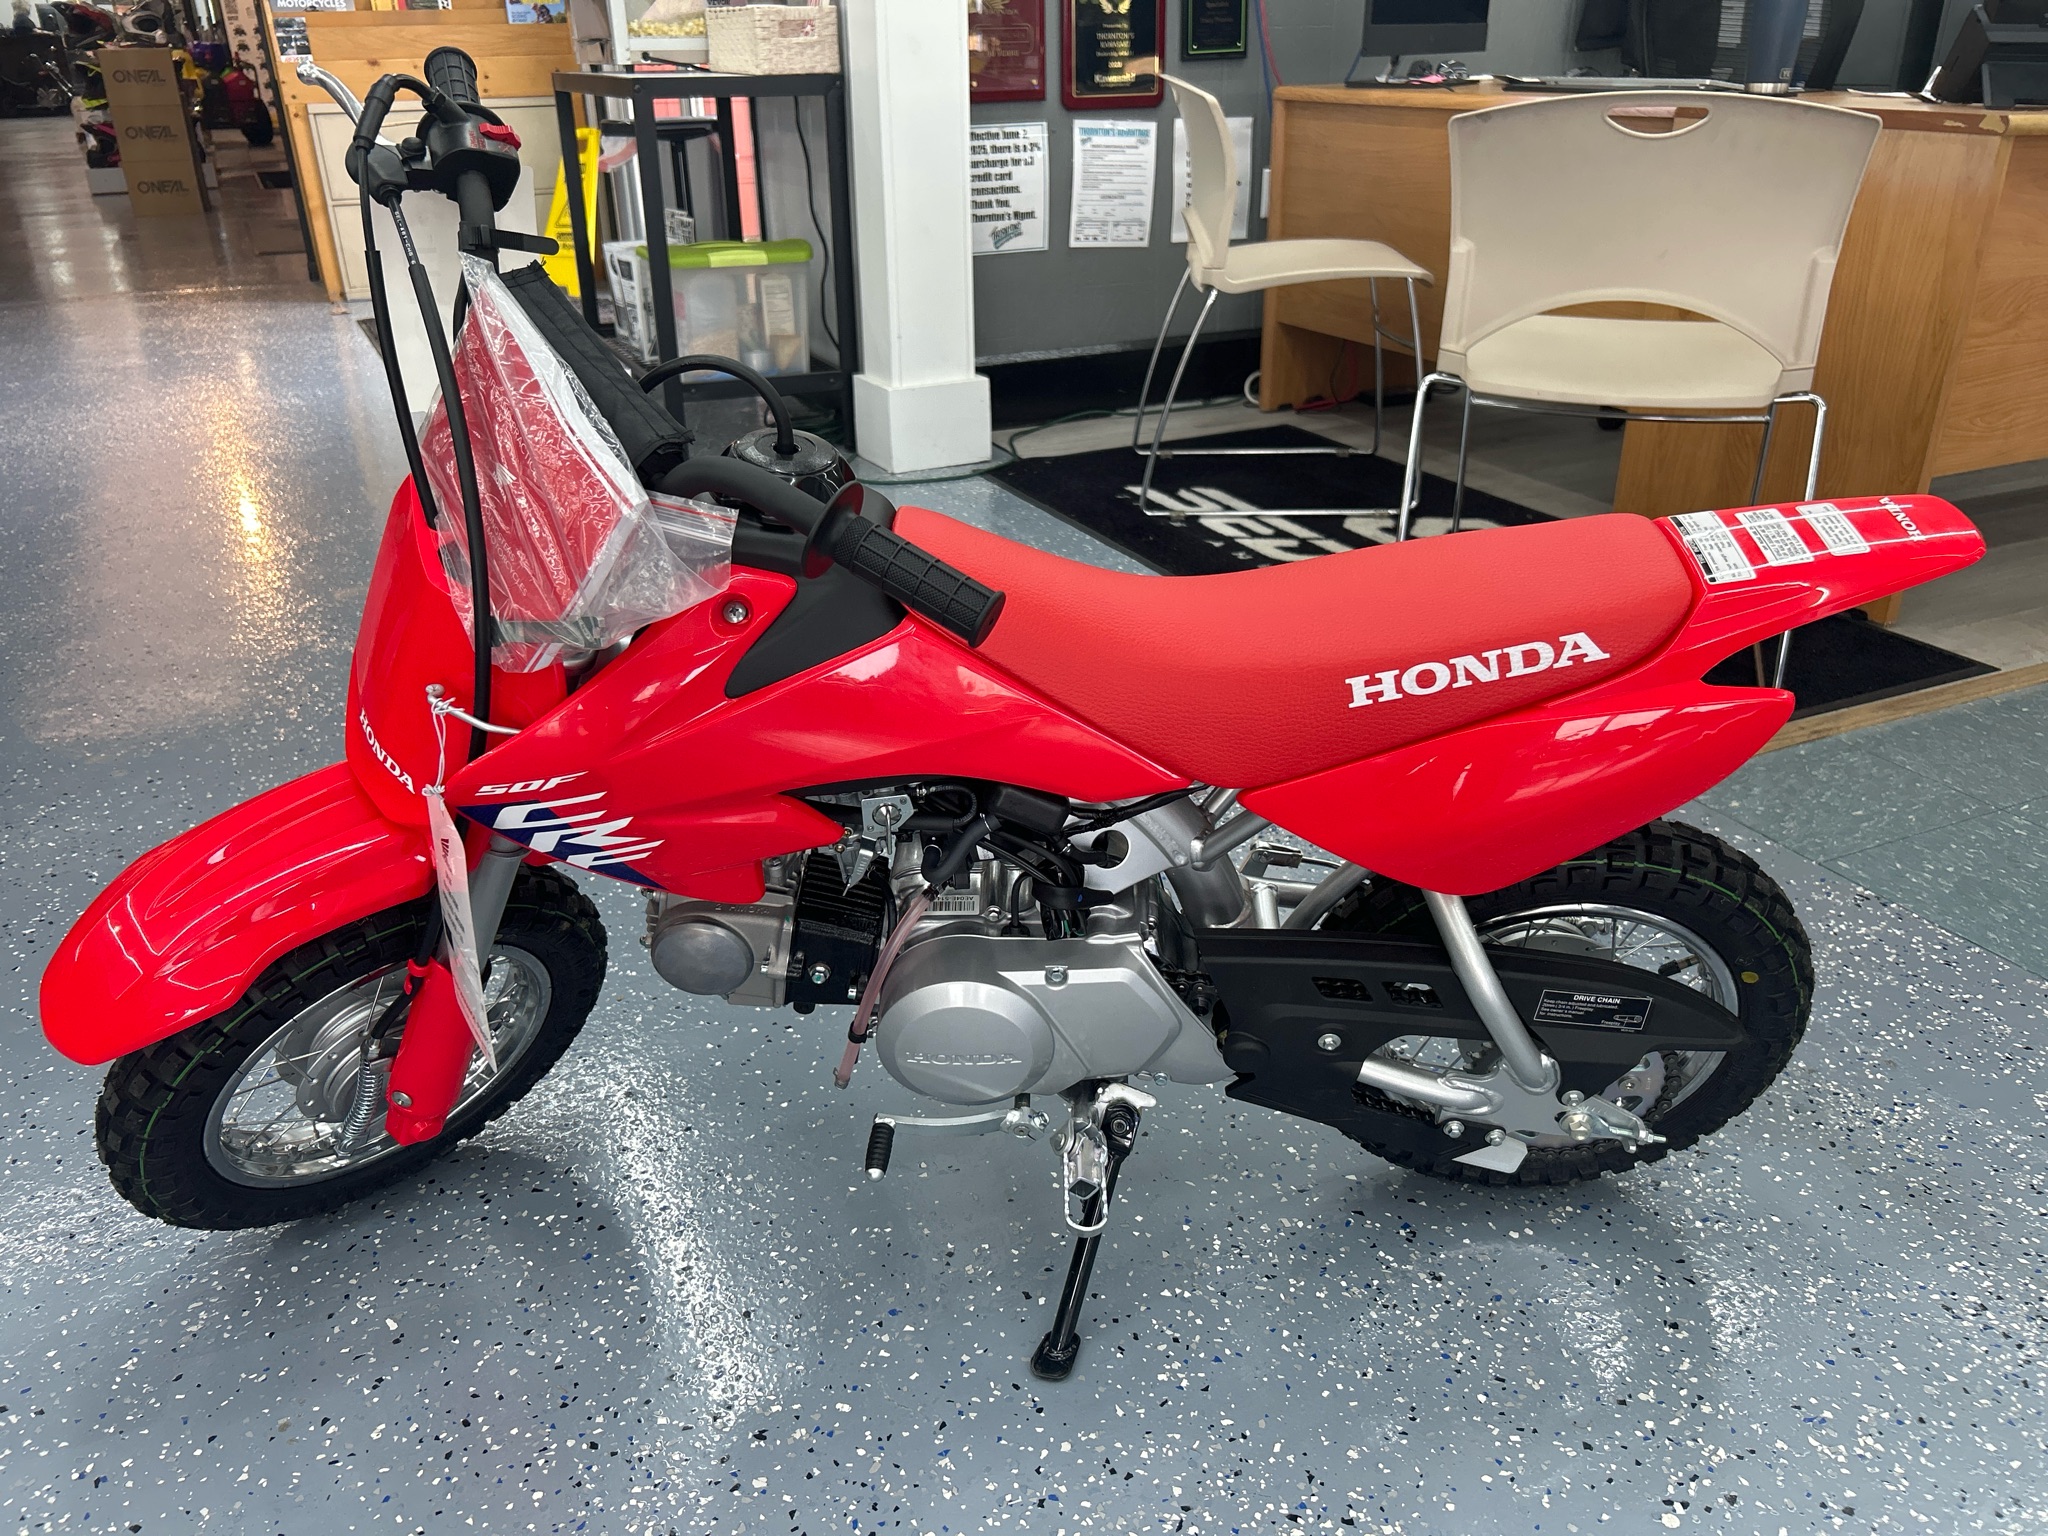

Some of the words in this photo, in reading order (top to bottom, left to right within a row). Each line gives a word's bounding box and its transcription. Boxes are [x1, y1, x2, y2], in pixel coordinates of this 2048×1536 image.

[971, 130, 1000, 141] ffective
[1002, 130, 1019, 140] June
[990, 144, 1012, 154] there
[1014, 143, 1020, 153] is
[971, 158, 1008, 169] urcharge
[1010, 157, 1021, 166] for
[994, 171, 1012, 180] card
[971, 185, 1022, 196] ransactions.
[1879, 497, 1926, 541] HONDA
[1345, 631, 1610, 708] HONDA
[360, 705, 415, 794] HONDA
[475, 771, 589, 796] 50F
[492, 791, 665, 868] CRF
[1573, 994, 1596, 1003] DRIVE
[1597, 996, 1620, 1004] CHAIN
[906, 1051, 1022, 1065] HONDA
